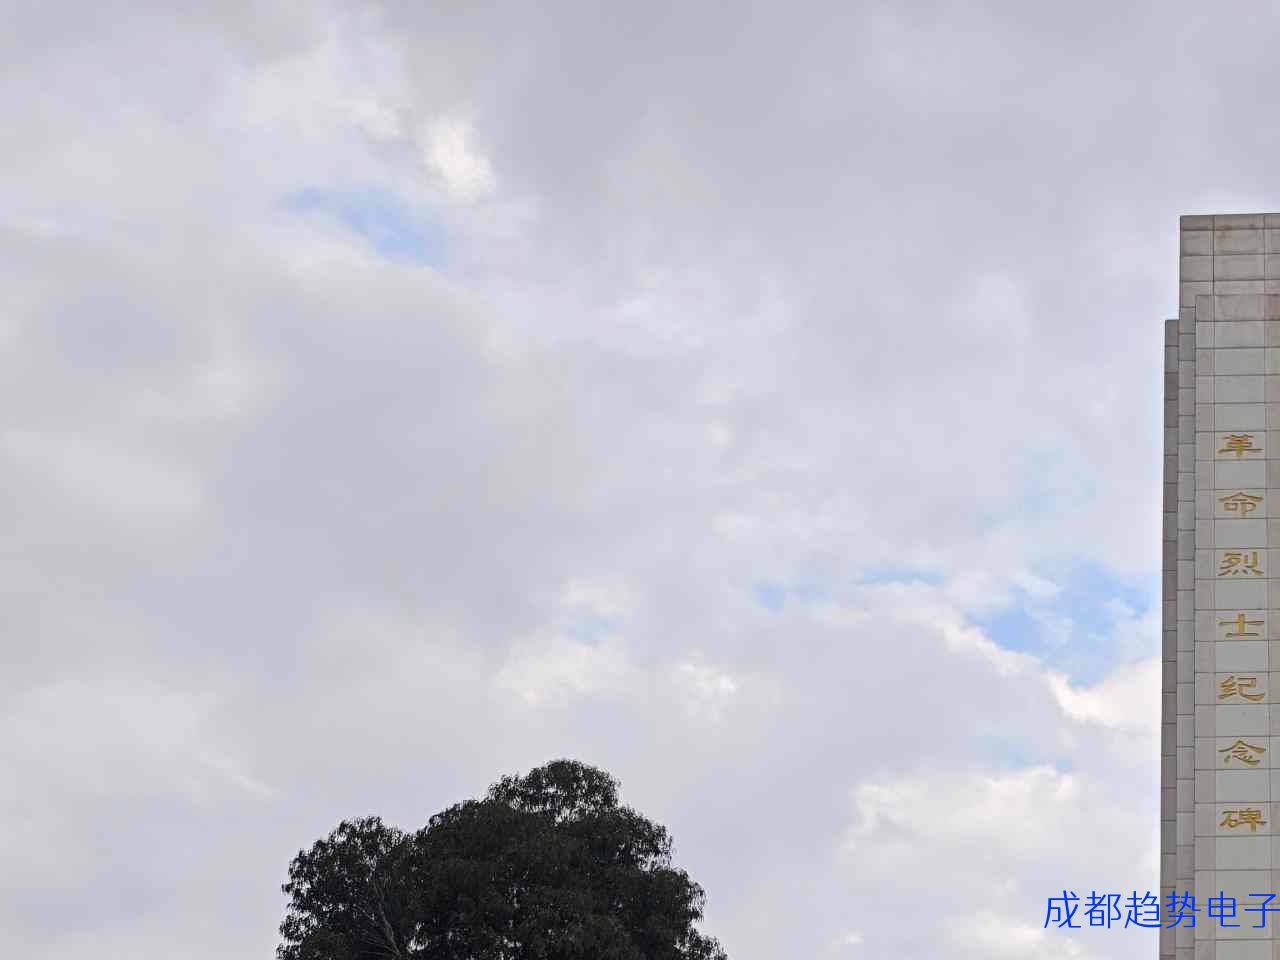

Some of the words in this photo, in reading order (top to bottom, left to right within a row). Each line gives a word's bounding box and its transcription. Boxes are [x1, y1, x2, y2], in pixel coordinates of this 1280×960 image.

[1218, 433, 1267, 832] 革命烈士纪念碑
